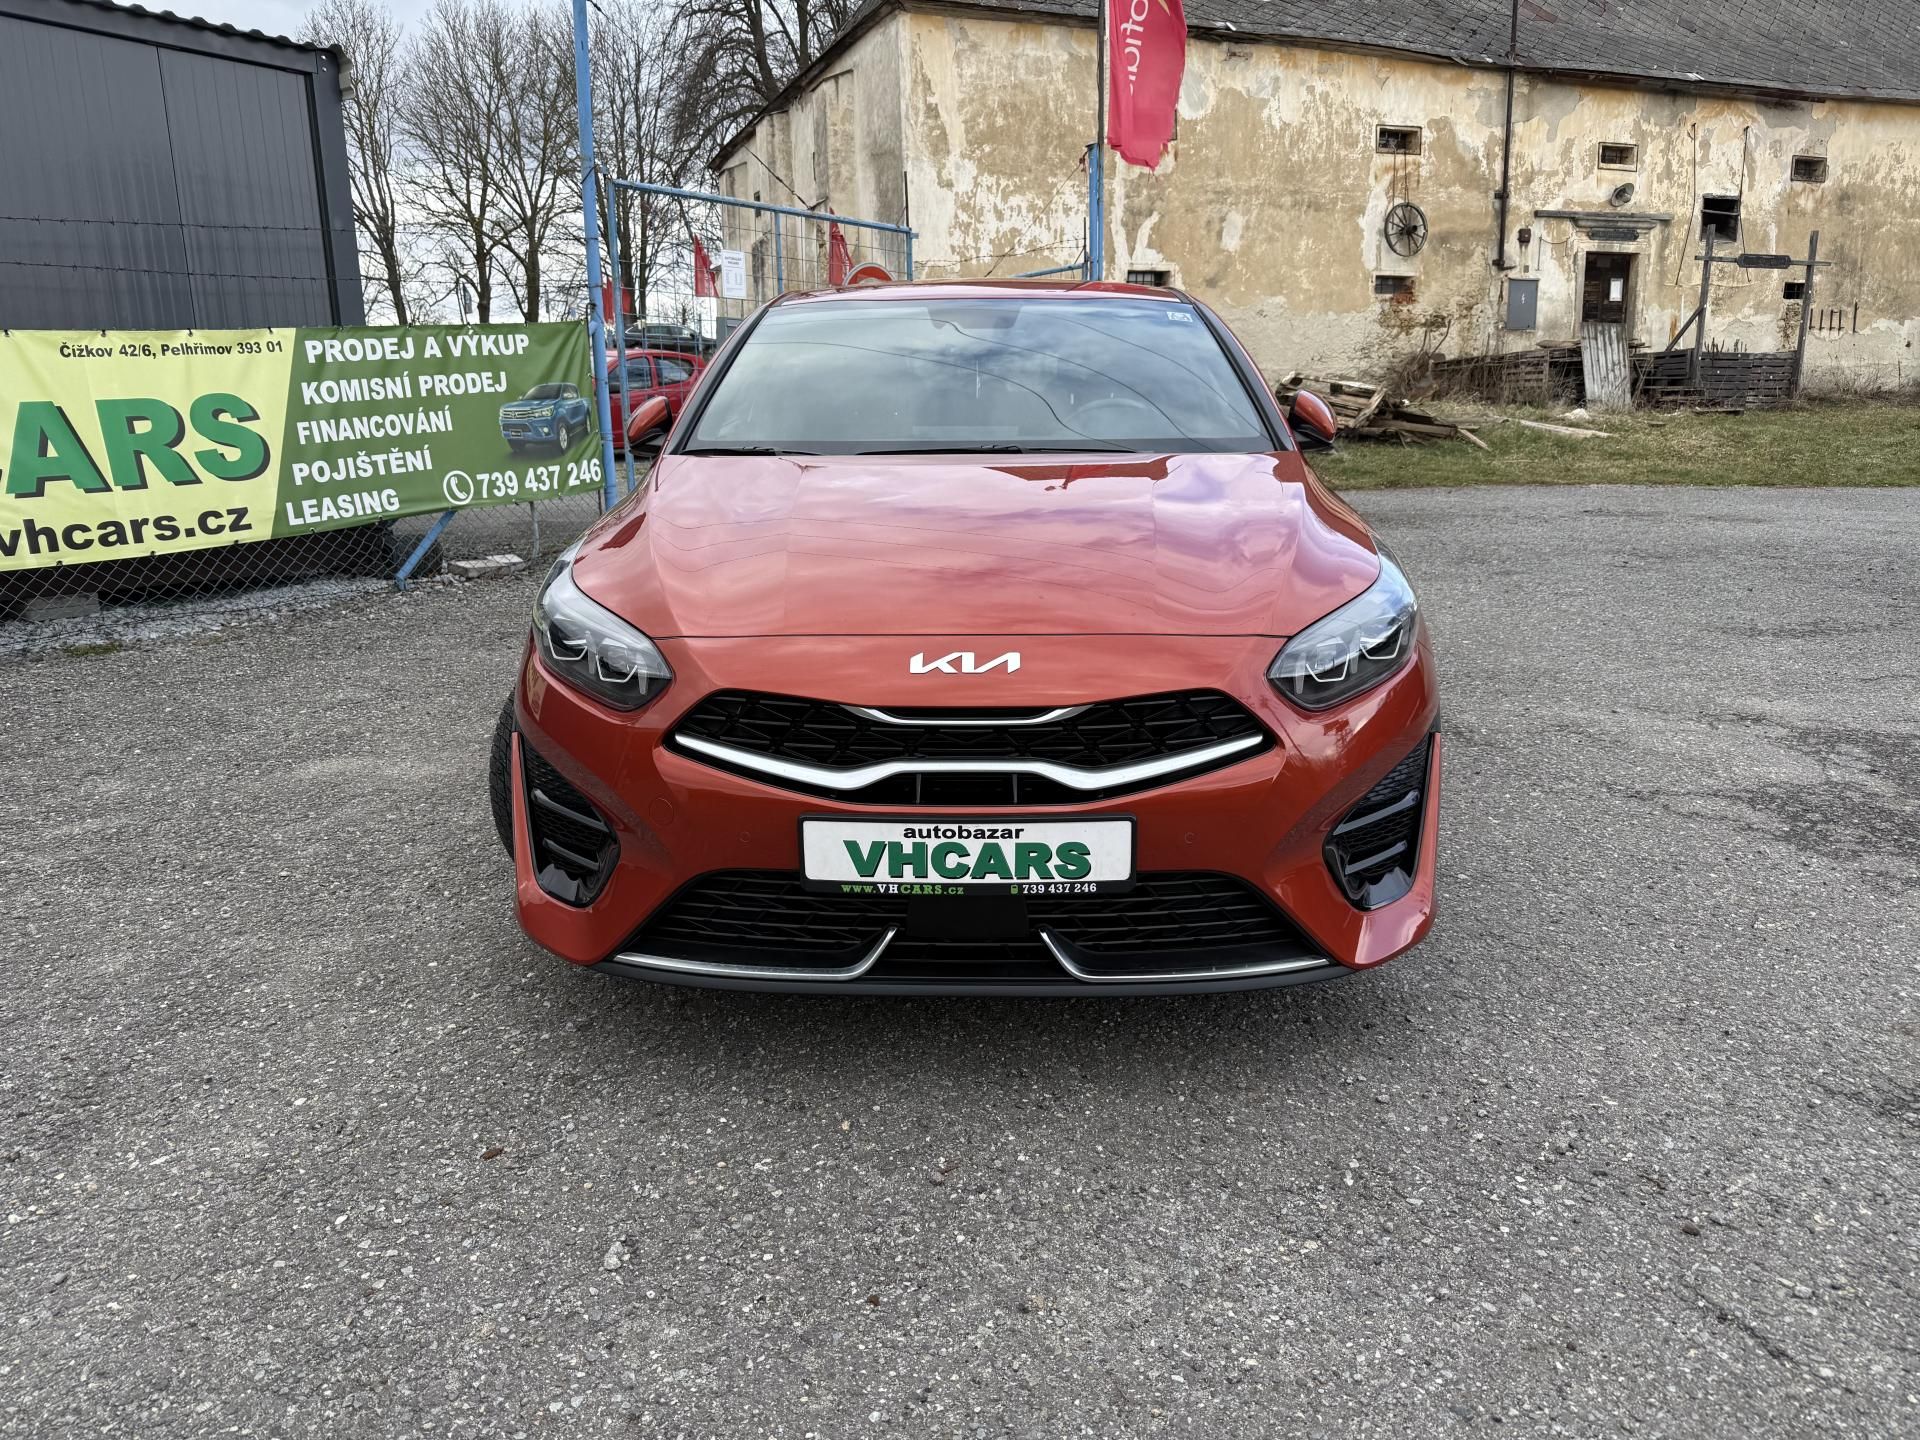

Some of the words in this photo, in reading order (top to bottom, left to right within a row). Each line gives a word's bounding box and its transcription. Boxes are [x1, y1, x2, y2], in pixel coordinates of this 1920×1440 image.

[59, 342, 113, 358] Čížkov
[119, 344, 157, 360] 42/6,
[161, 342, 232, 357] Pelhřimov
[237, 342, 262, 355] 393
[266, 341, 283, 353] 01
[304, 337, 415, 364] PRODEJ
[424, 336, 442, 358] A
[446, 329, 530, 357] VÝKUP
[301, 371, 412, 405] KOMISNÍ
[418, 371, 507, 397] PRODEJ
[296, 405, 453, 444] FINANCOVÁNÍ
[0, 392, 271, 499] ARS
[291, 444, 433, 485] POJIŠTĚNÍ
[476, 470, 519, 498] 739
[525, 465, 560, 492] 437
[567, 458, 602, 486] 246
[285, 488, 400, 526] LEASING
[903, 825, 1025, 839] autobazar
[843, 840, 1092, 880] VHCARS
[841, 884, 965, 895] www.VHCARS.cz
[1022, 884, 1045, 894] 739
[1048, 883, 1071, 893] 437
[1074, 883, 1097, 893] 246
